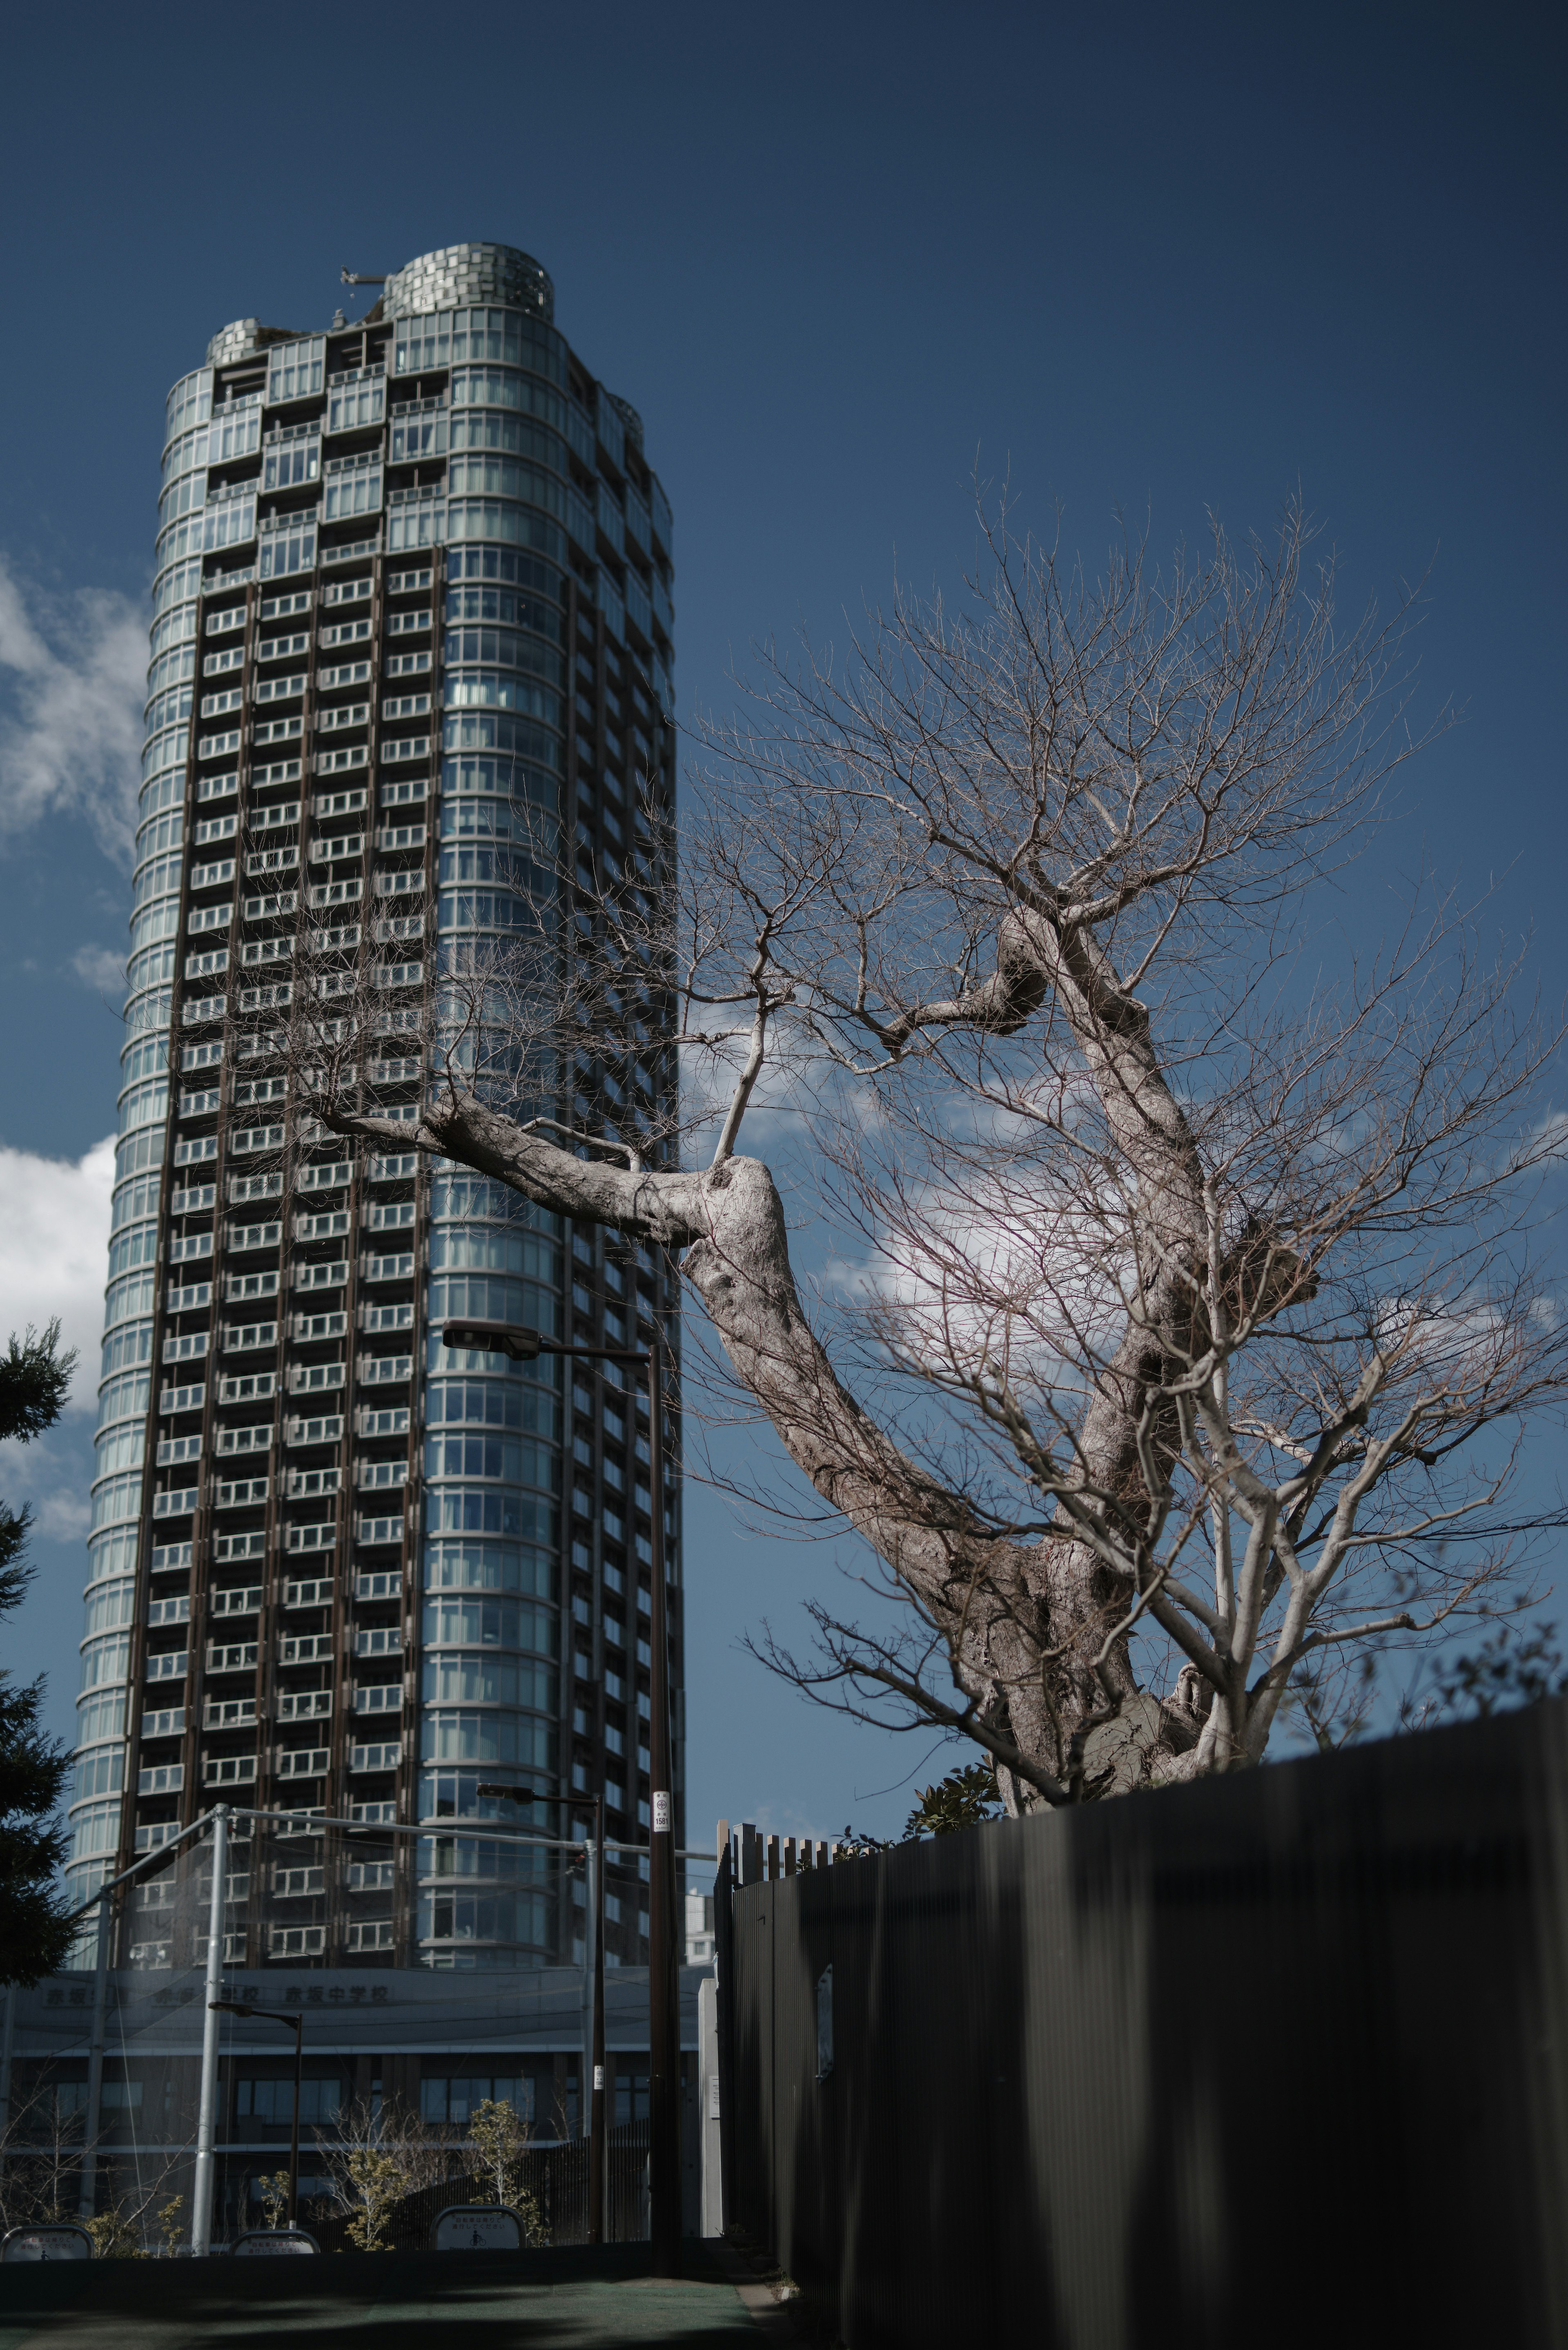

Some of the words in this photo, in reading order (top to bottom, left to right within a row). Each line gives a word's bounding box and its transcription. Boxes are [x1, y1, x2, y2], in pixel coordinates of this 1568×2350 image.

[285, 1985, 388, 2002] 赤坂中学校
